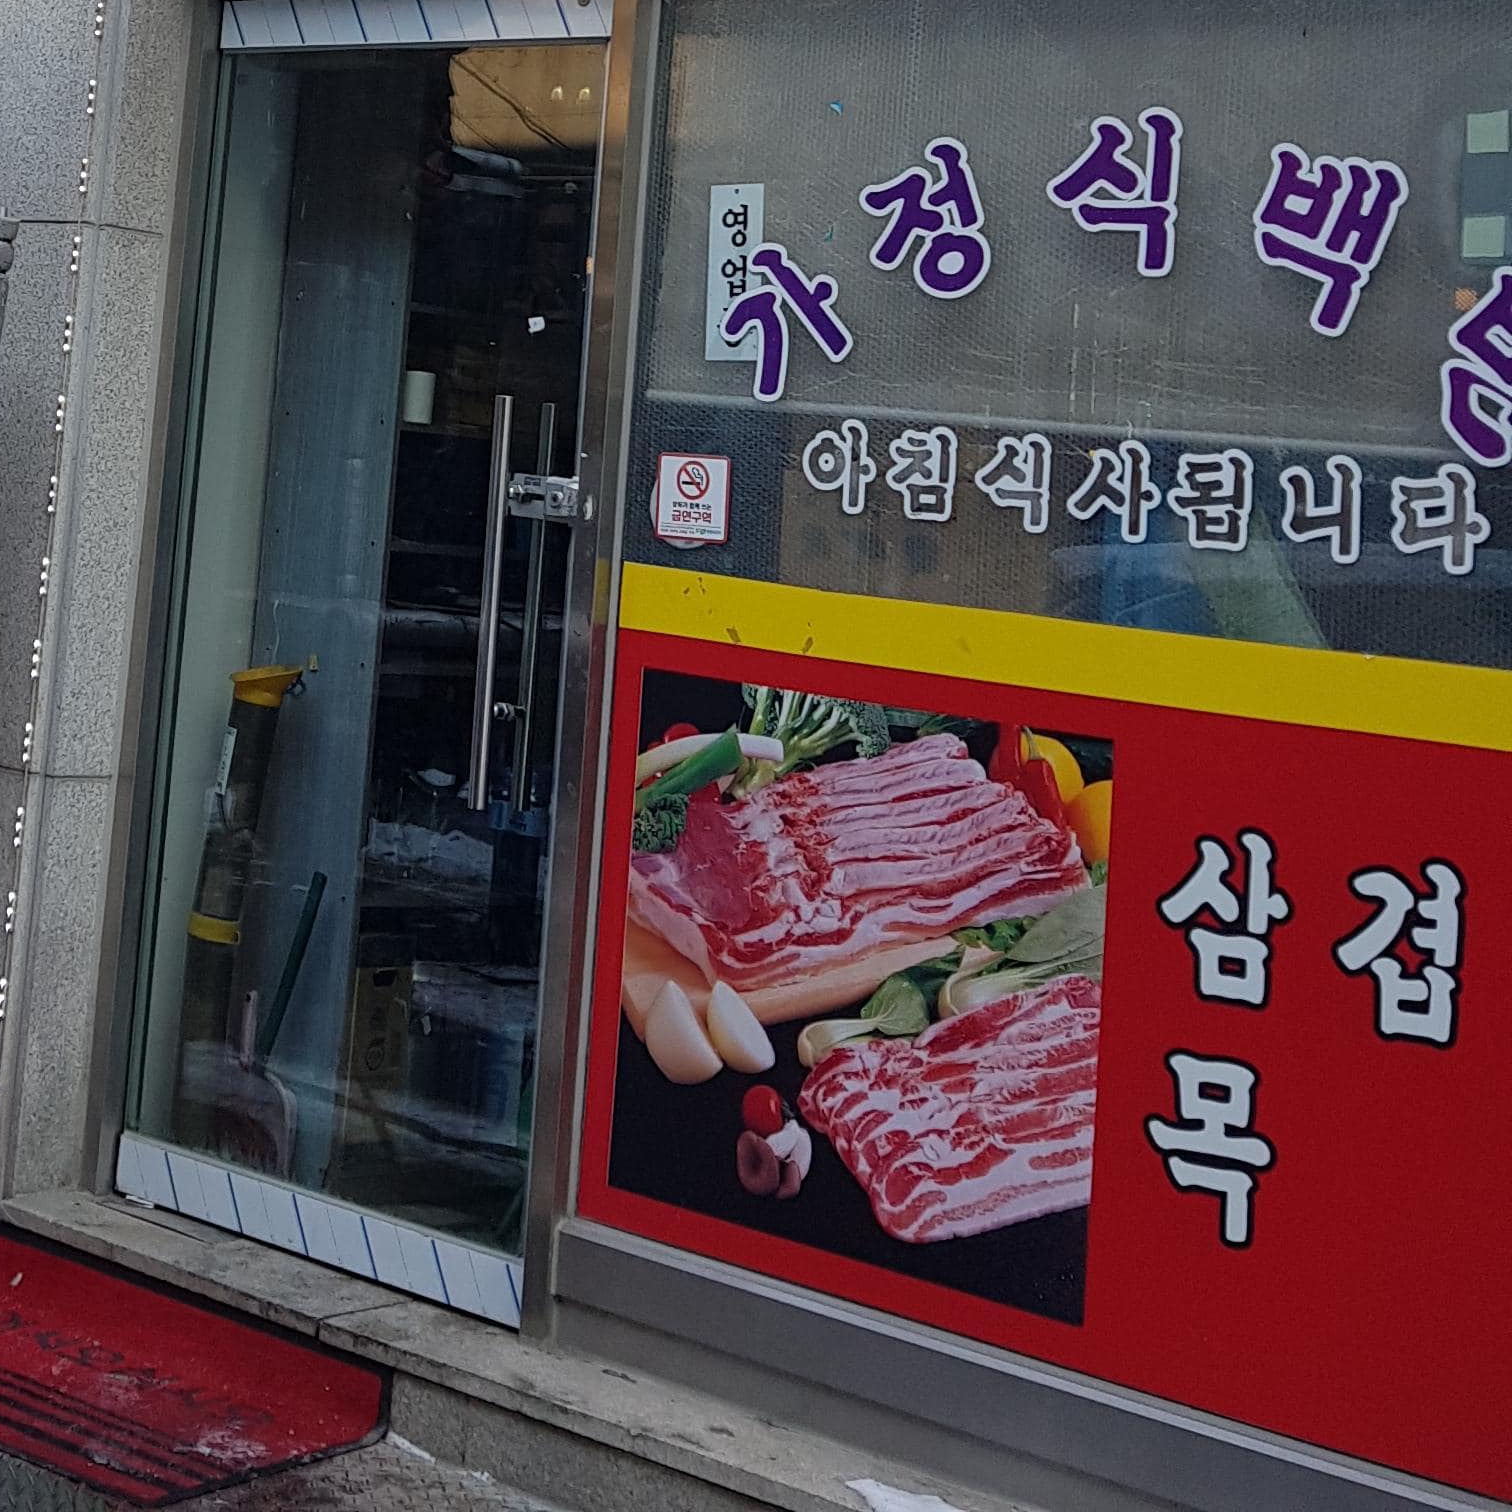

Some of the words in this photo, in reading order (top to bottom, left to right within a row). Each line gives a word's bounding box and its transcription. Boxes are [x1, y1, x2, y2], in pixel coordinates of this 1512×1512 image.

[718, 203, 749, 348] 영업
[671, 509, 712, 524] 금연구역
[1148, 1052, 1276, 1247] 목
